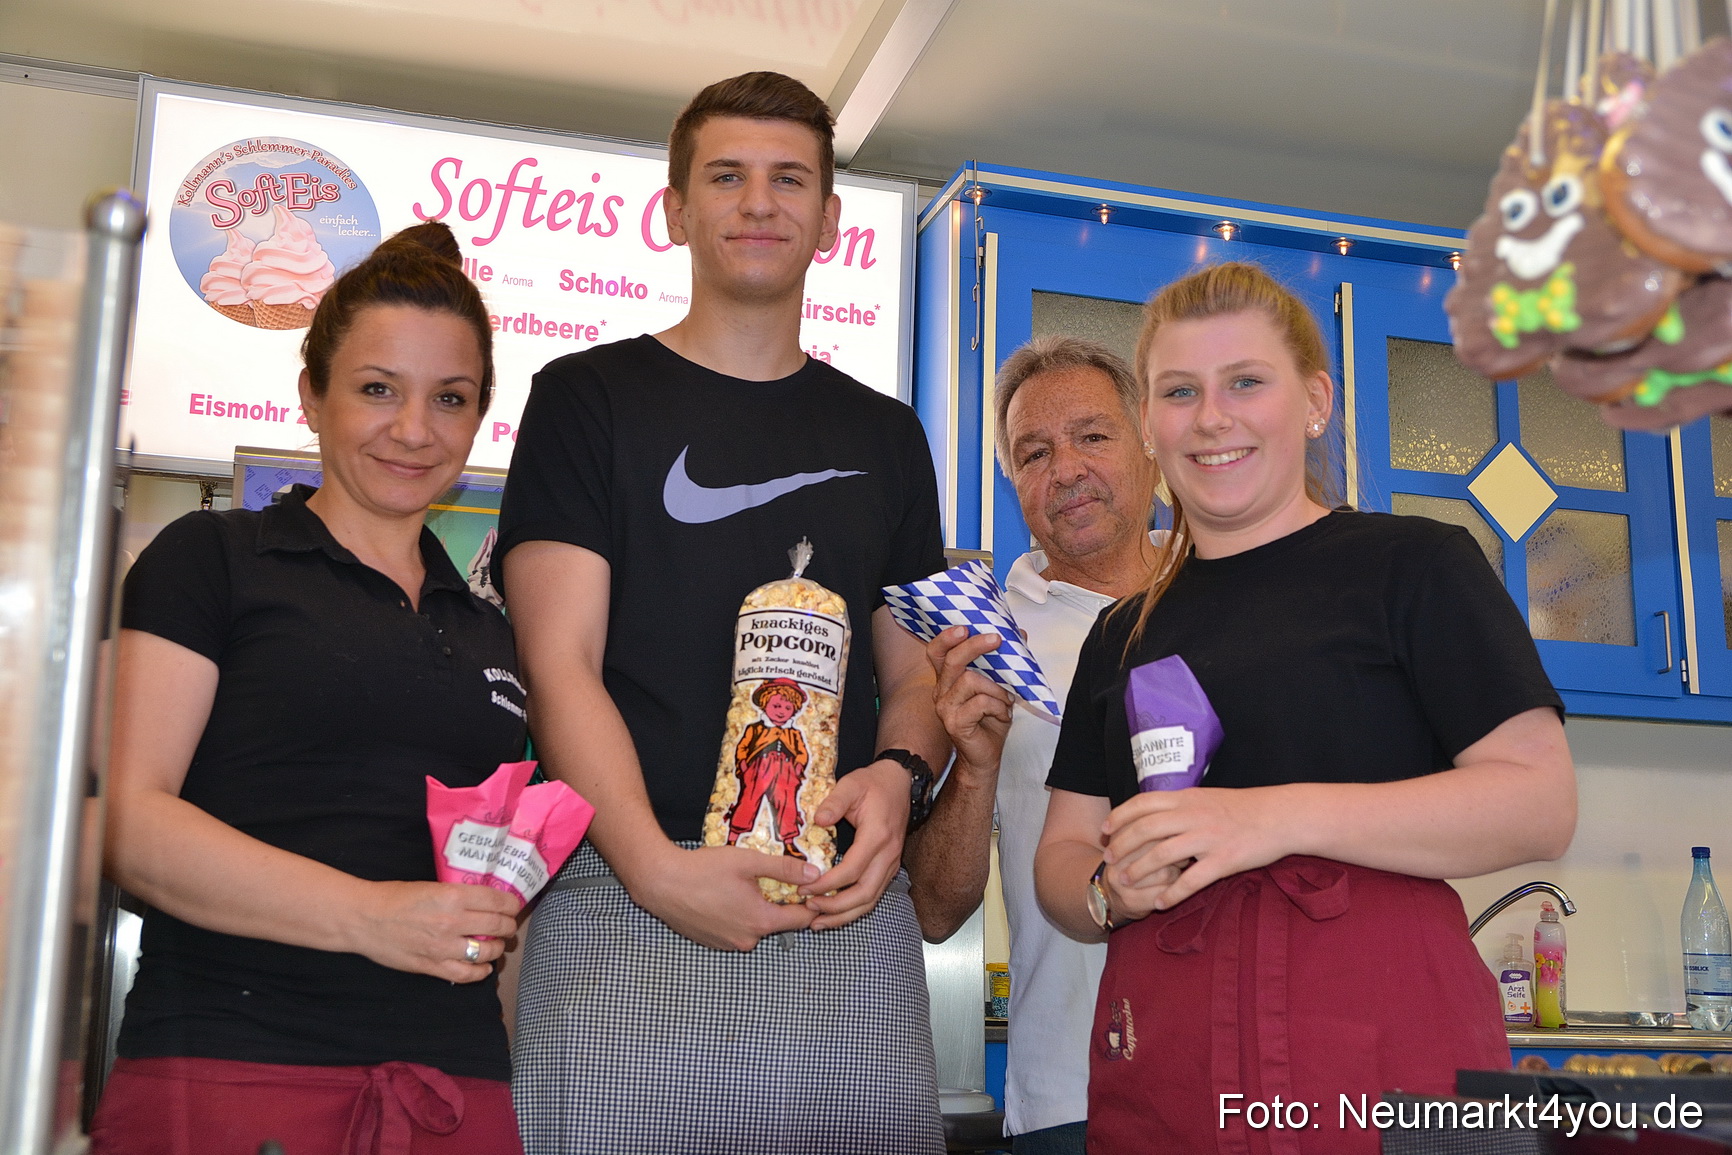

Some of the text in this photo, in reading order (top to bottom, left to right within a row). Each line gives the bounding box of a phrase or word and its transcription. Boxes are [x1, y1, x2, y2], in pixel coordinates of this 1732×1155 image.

[177, 139, 358, 207] Kollmann's Schlemmer-Paradies
[412, 157, 625, 247] Softeis
[319, 213, 359, 228] einfach
[502, 274, 534, 288] Aroma
[558, 268, 649, 300] Schoko
[658, 291, 689, 305] Aroma
[189, 393, 290, 423] Eismohr
[751, 617, 829, 637] knackiges
[739, 632, 836, 661] Popcorn
[765, 665, 795, 676] frisch
[797, 669, 832, 686] geröstet
